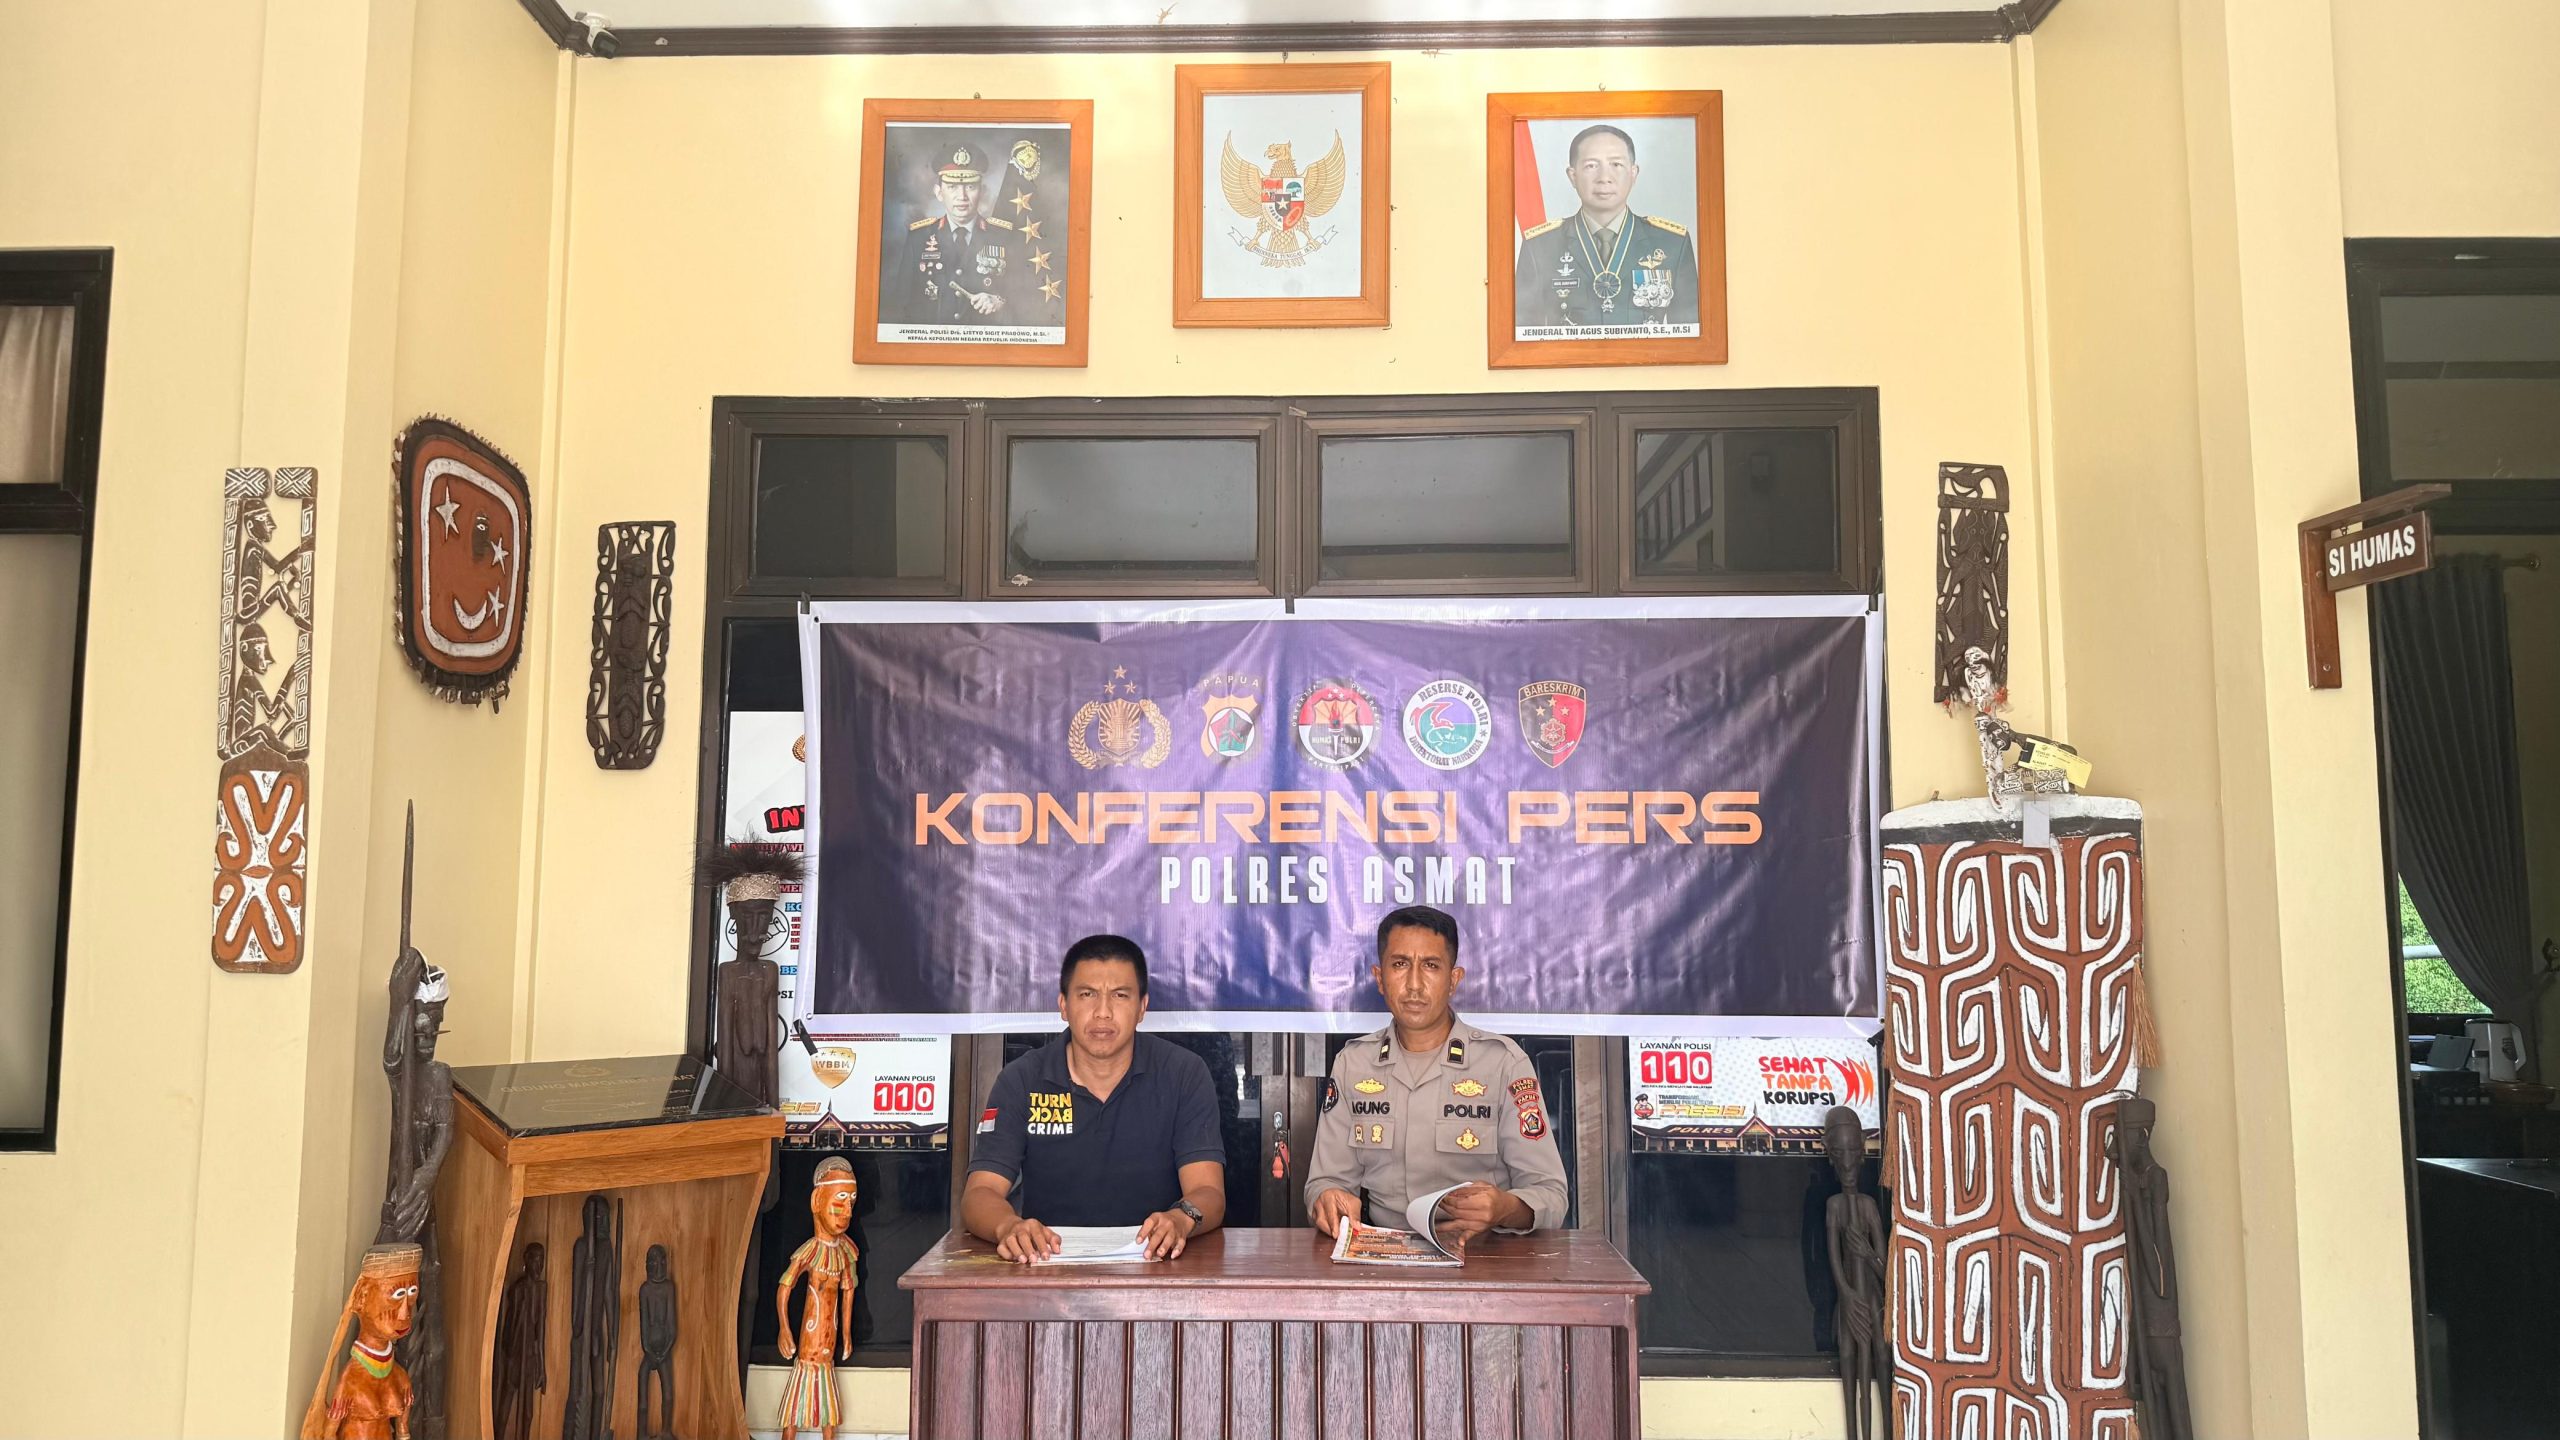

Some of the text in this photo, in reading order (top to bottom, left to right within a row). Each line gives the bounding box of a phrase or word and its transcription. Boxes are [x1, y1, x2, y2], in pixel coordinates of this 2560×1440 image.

[1522, 328, 1564, 336] JENDERAL
[1565, 328, 1579, 336] TNI
[1580, 327, 1602, 336] AGUS
[1604, 326, 1651, 336] SUBIYANTO,
[1652, 326, 1671, 336] S.E.,
[2329, 525, 2416, 577] SI HUMAS
[1203, 675, 1259, 687] PAPUA
[1523, 682, 1581, 697] BARESKRIM
[1418, 683, 1489, 726] RESERSE POLRI
[1409, 735, 1484, 766] DIREKTORAT NARKOBA
[914, 790, 1764, 846] KONFERENSI PERS
[1161, 856, 1517, 905] POLRES ASMAT
[778, 990, 794, 999] SI
[815, 1060, 850, 1069] WBBM
[1643, 1054, 1710, 1081] 110
[1758, 1056, 1828, 1074] SEHAT
[501, 1083, 566, 1093] GEDUNG
[1761, 1073, 1833, 1091] TANPA
[875, 1085, 934, 1109] 110
[1029, 1093, 1072, 1108] TURN
[1518, 1094, 1536, 1104] PAPUA
[1763, 1090, 1836, 1106] KORUPSI
[1443, 1104, 1491, 1119] POLRI
[1027, 1122, 1073, 1135] CRIME
